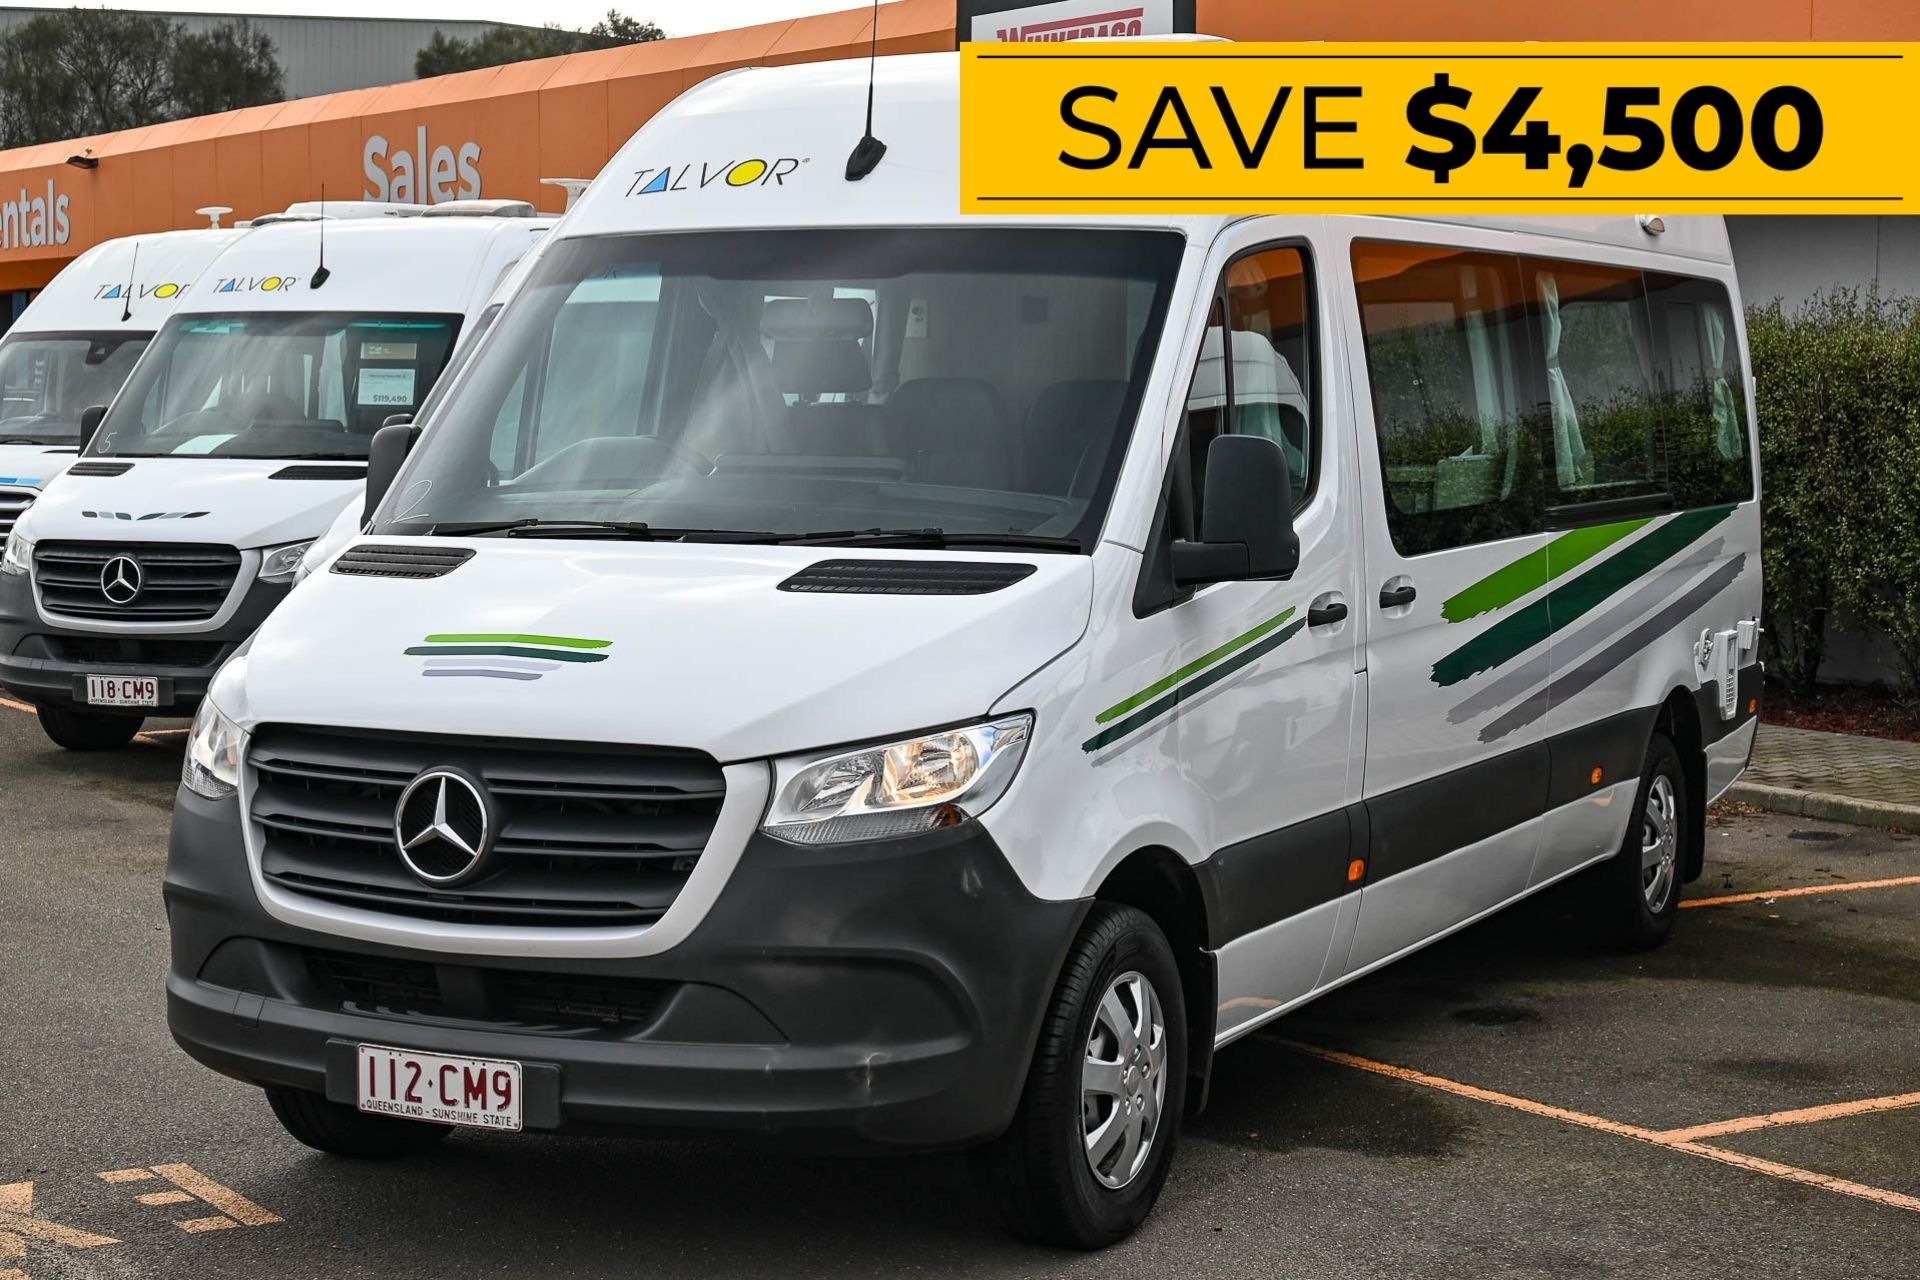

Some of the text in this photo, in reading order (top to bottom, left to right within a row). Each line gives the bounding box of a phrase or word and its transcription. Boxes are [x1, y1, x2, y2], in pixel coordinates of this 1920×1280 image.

[363, 125, 482, 205] Sales
[0, 178, 70, 249] ntals
[366, 1099, 424, 1116] QUEENSLAND
[432, 1108, 478, 1124] SUNSHINE
[483, 1114, 512, 1127] STATE
